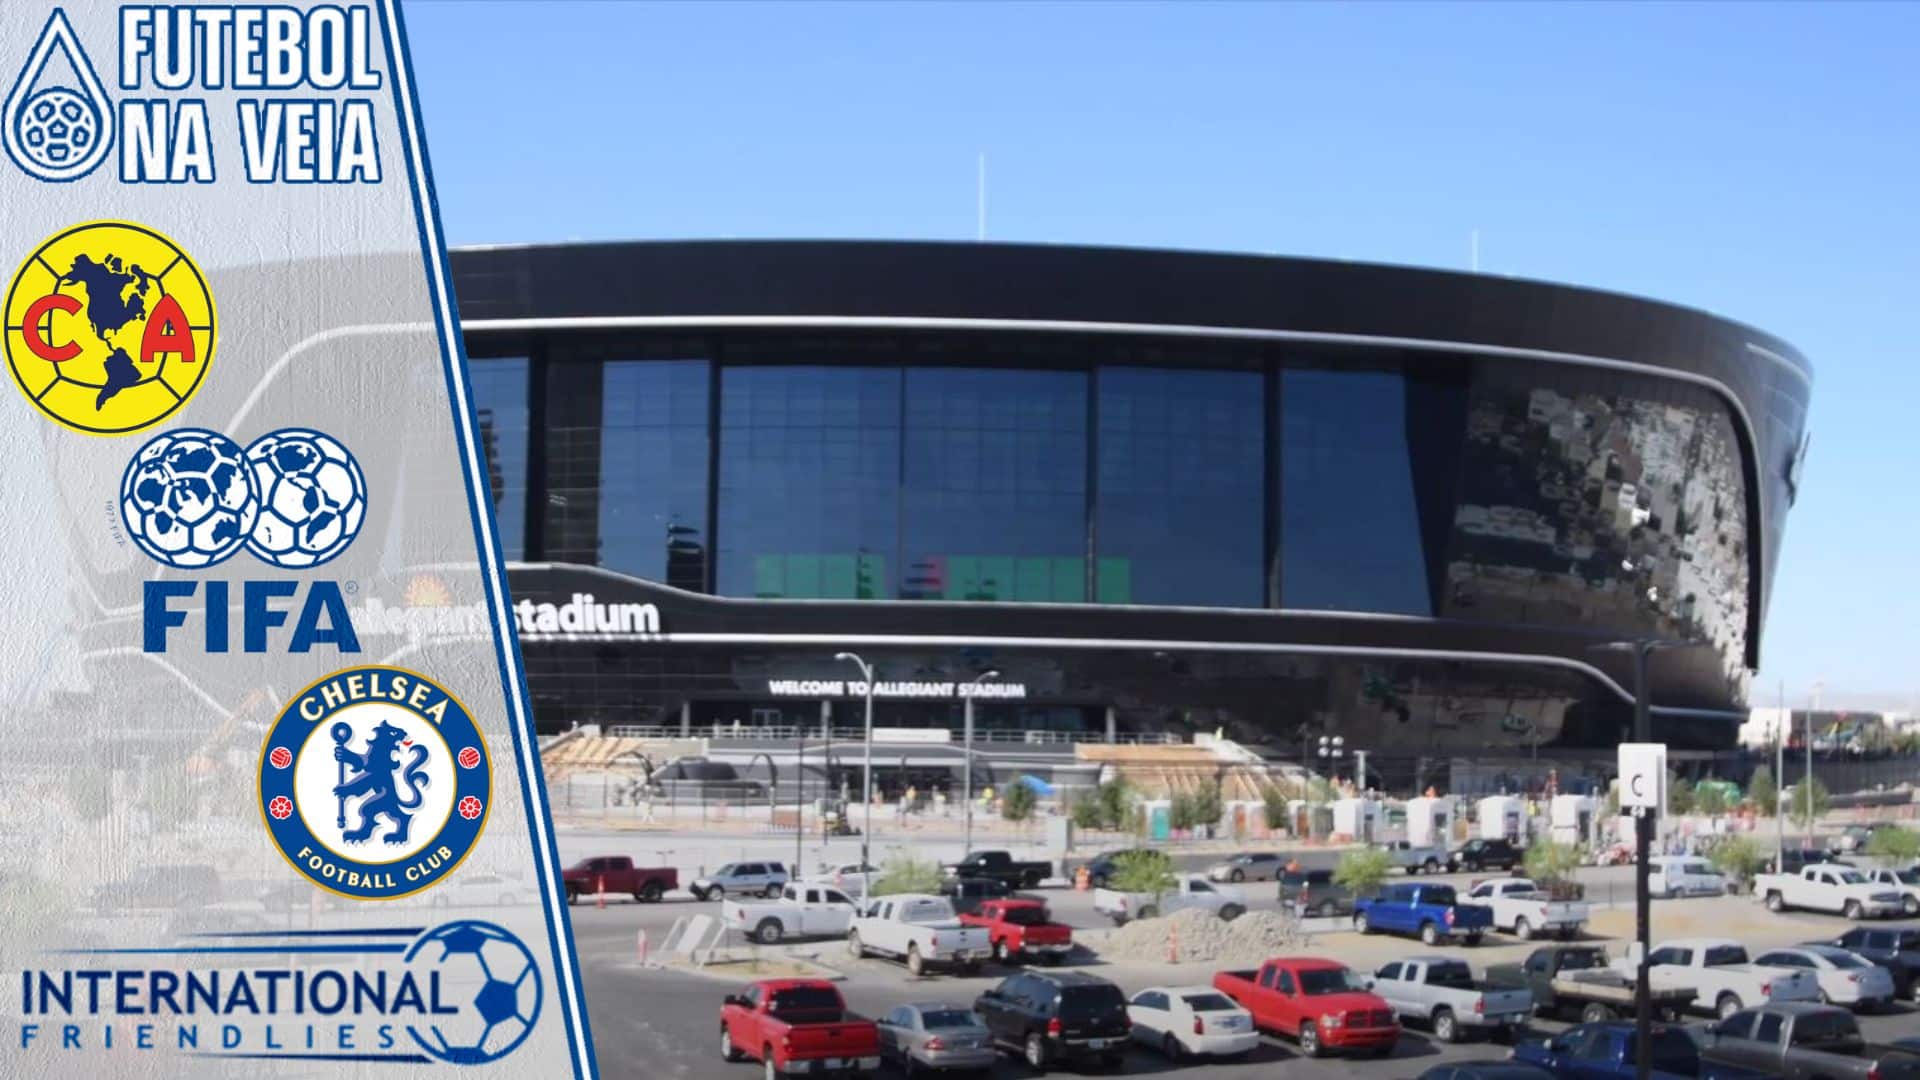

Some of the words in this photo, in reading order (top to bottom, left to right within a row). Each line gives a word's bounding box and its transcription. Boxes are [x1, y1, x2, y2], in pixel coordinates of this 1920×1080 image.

[768, 680, 844, 696] WELCOME
[847, 681, 871, 696] TO
[872, 681, 955, 697] ALLEGIANT
[957, 682, 1026, 698] STADIUM
[1631, 773, 1643, 797] C
